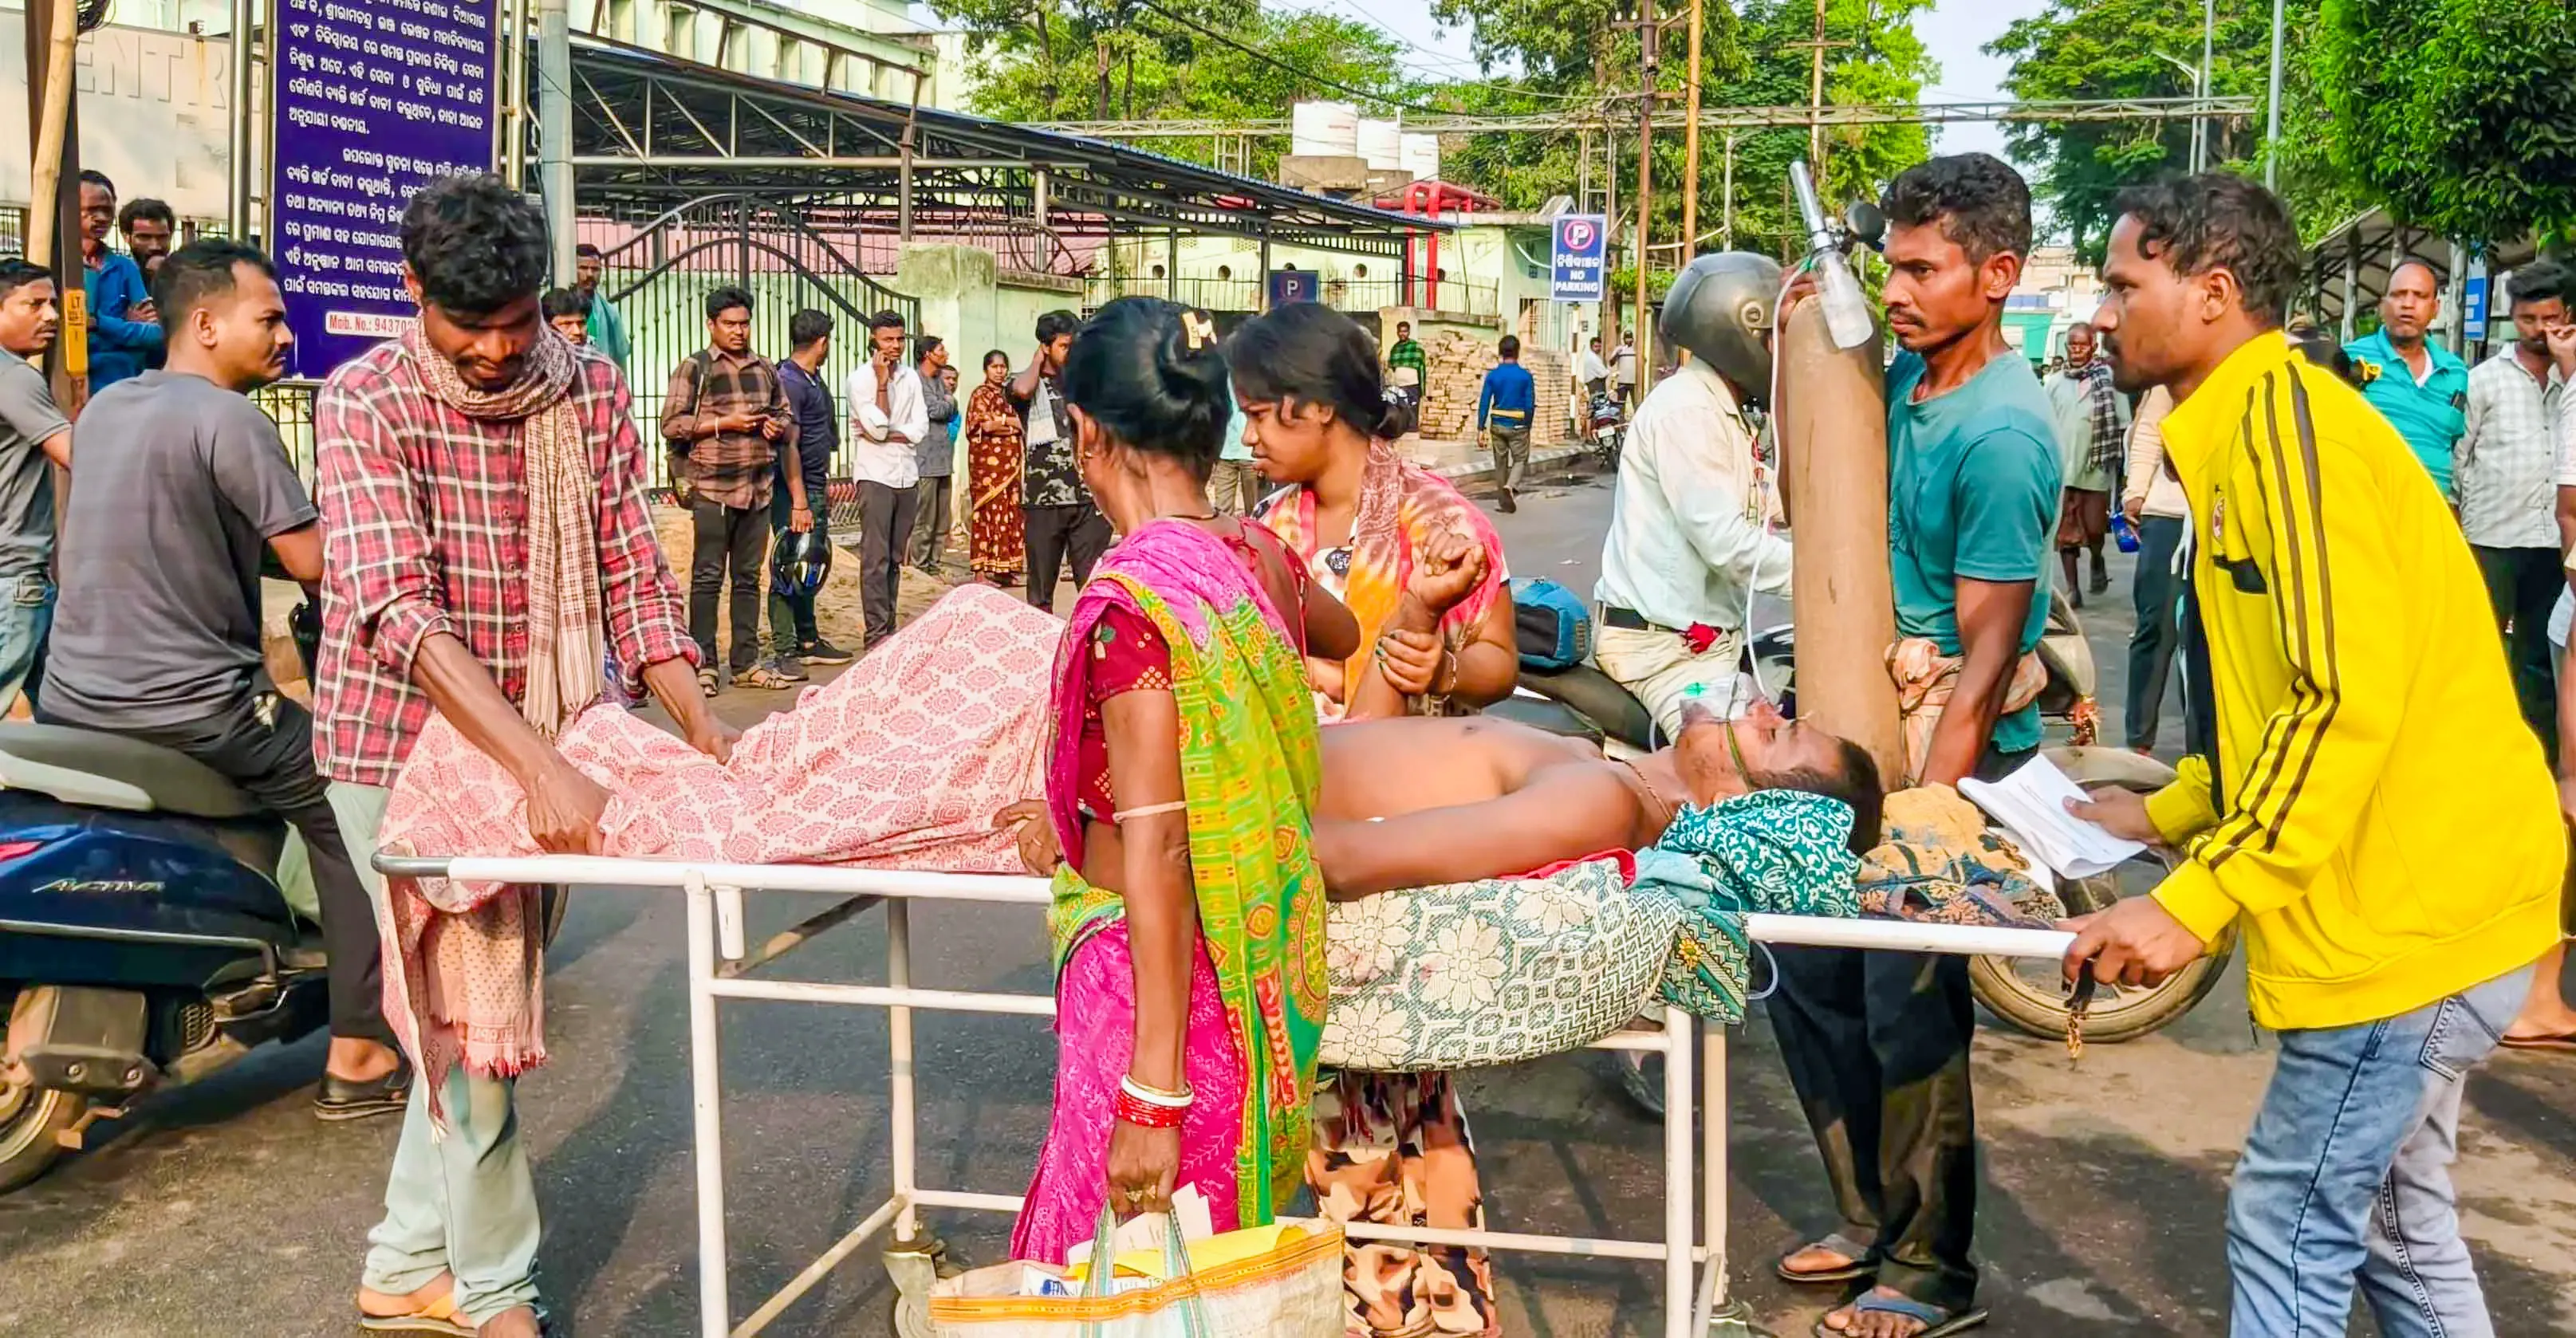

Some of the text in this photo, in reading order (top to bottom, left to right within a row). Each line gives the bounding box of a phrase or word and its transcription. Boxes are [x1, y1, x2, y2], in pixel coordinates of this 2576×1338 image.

[1570, 270, 1585, 281] NO
[1286, 279, 1298, 297] P
[1555, 281, 1598, 293] PARKING
[329, 315, 352, 331] Mob.
